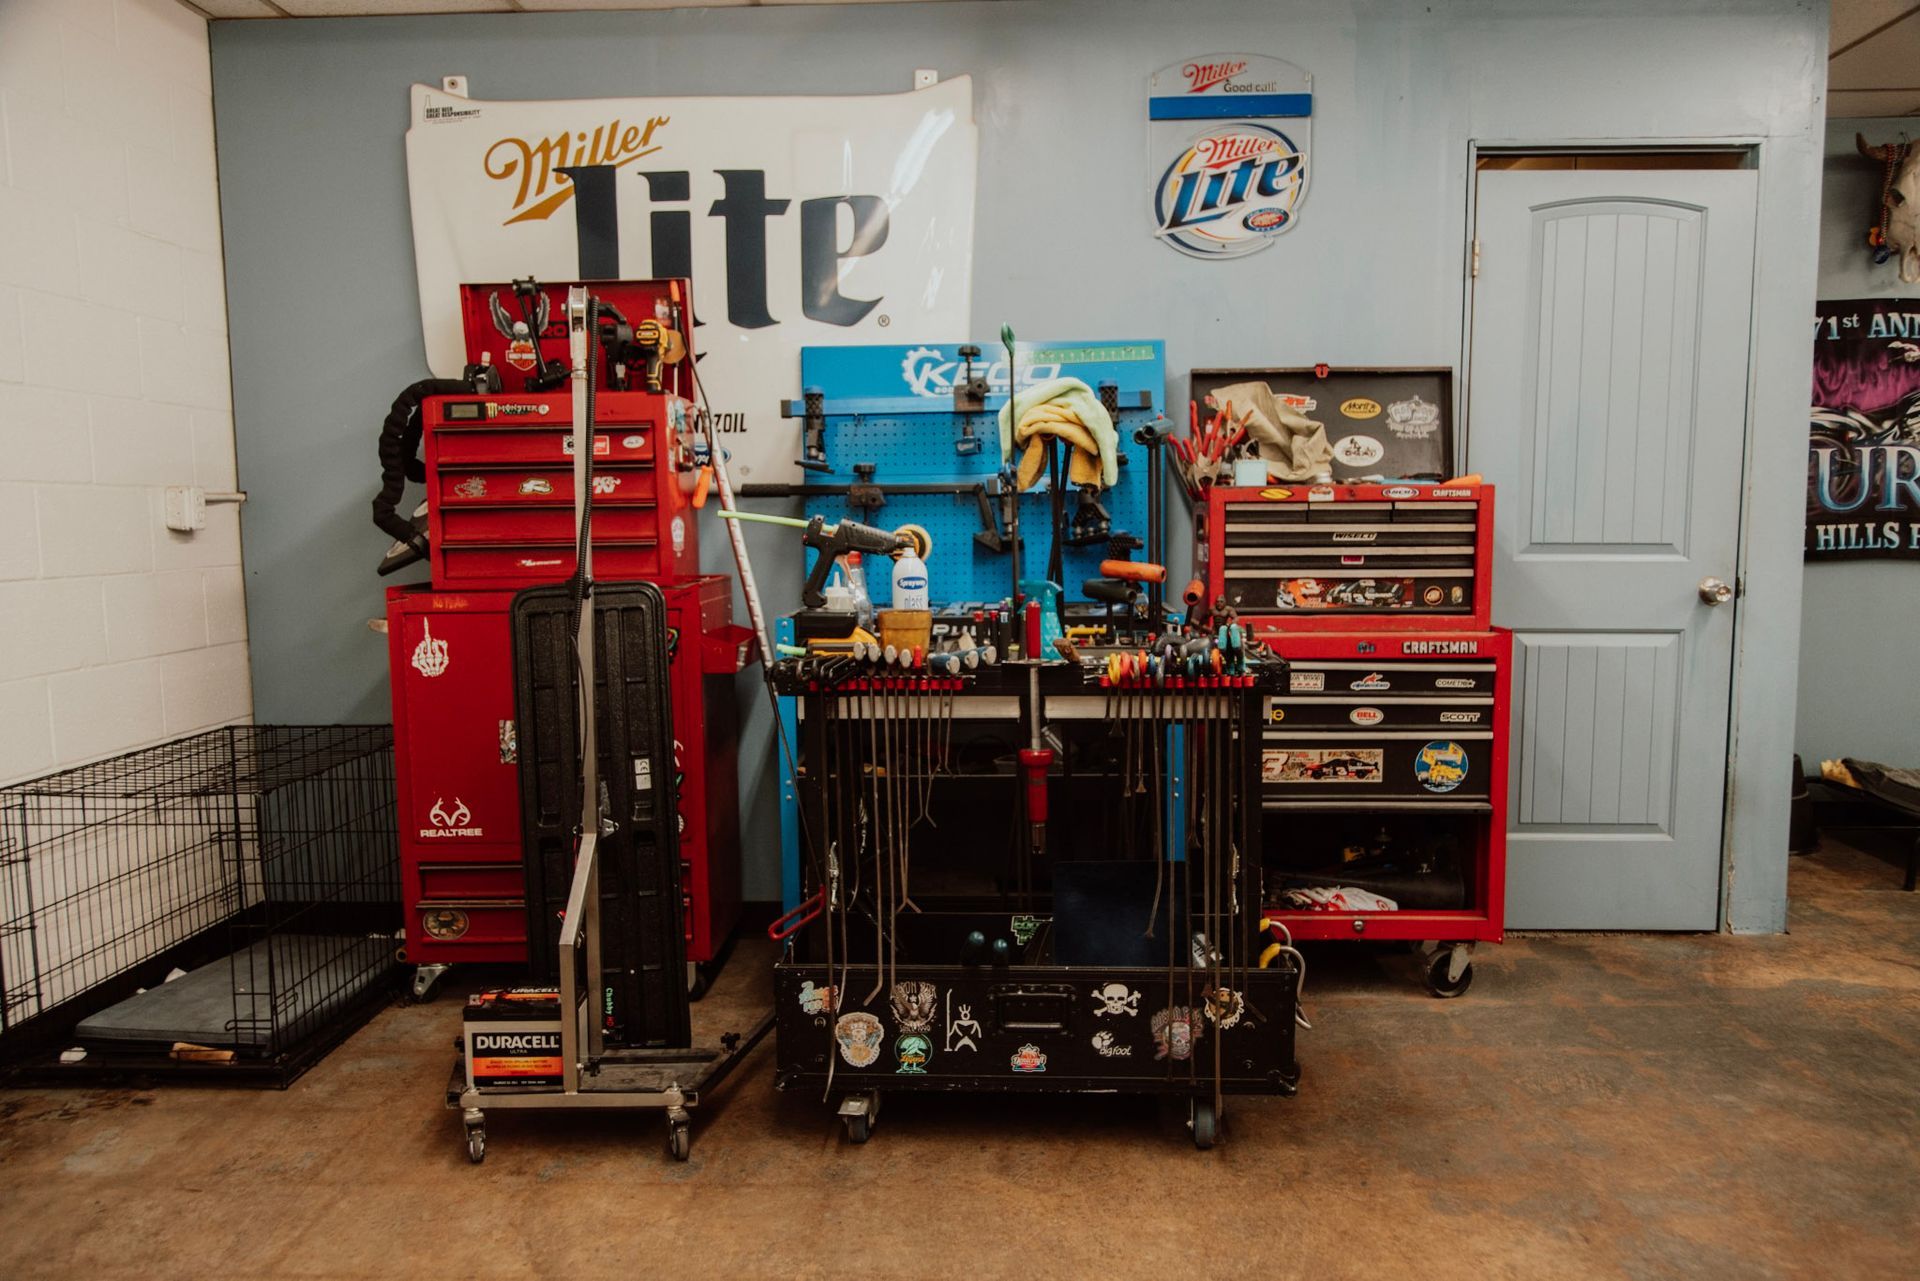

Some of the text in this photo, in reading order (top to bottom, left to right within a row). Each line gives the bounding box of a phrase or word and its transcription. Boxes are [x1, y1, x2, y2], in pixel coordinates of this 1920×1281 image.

[1183, 60, 1248, 93] Miller
[1224, 82, 1253, 93] Good
[1197, 138, 1278, 169] Miller
[484, 115, 671, 226] Miller
[498, 403, 538, 412] MONSTER
[1432, 489, 1471, 497] CRAFTSMAN
[1816, 522, 1900, 550] HILLS
[1402, 641, 1478, 654] CRAFTSMAN
[1356, 711, 1377, 719] BELL
[1441, 712, 1479, 721] SCOTT
[420, 827, 483, 838] REALTREE
[476, 1035, 559, 1049] DURACELL
